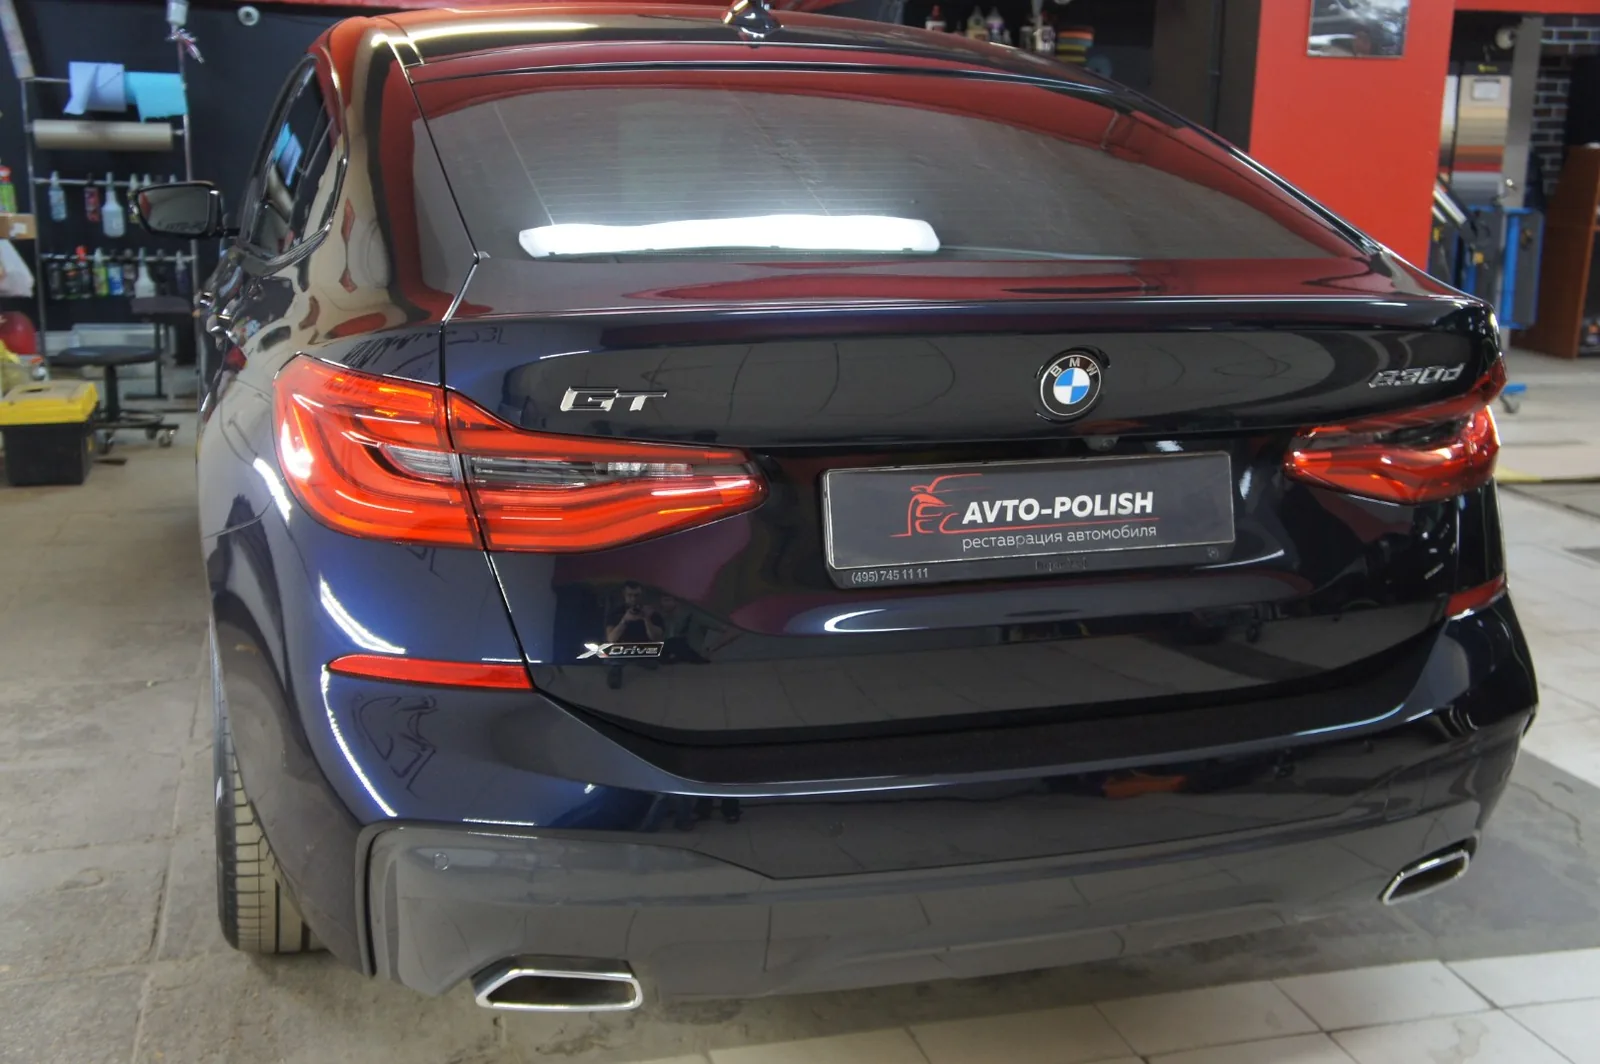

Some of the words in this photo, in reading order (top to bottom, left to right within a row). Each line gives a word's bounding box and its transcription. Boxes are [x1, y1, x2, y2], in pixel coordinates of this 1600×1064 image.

[1050, 357, 1098, 377] BMW
[560, 386, 668, 412] GT
[962, 491, 1154, 525] AVTO-POLISH
[962, 532, 1063, 551] реставрация
[1067, 524, 1157, 543] автомобиля
[851, 570, 879, 584] (495)
[880, 569, 900, 581] 745
